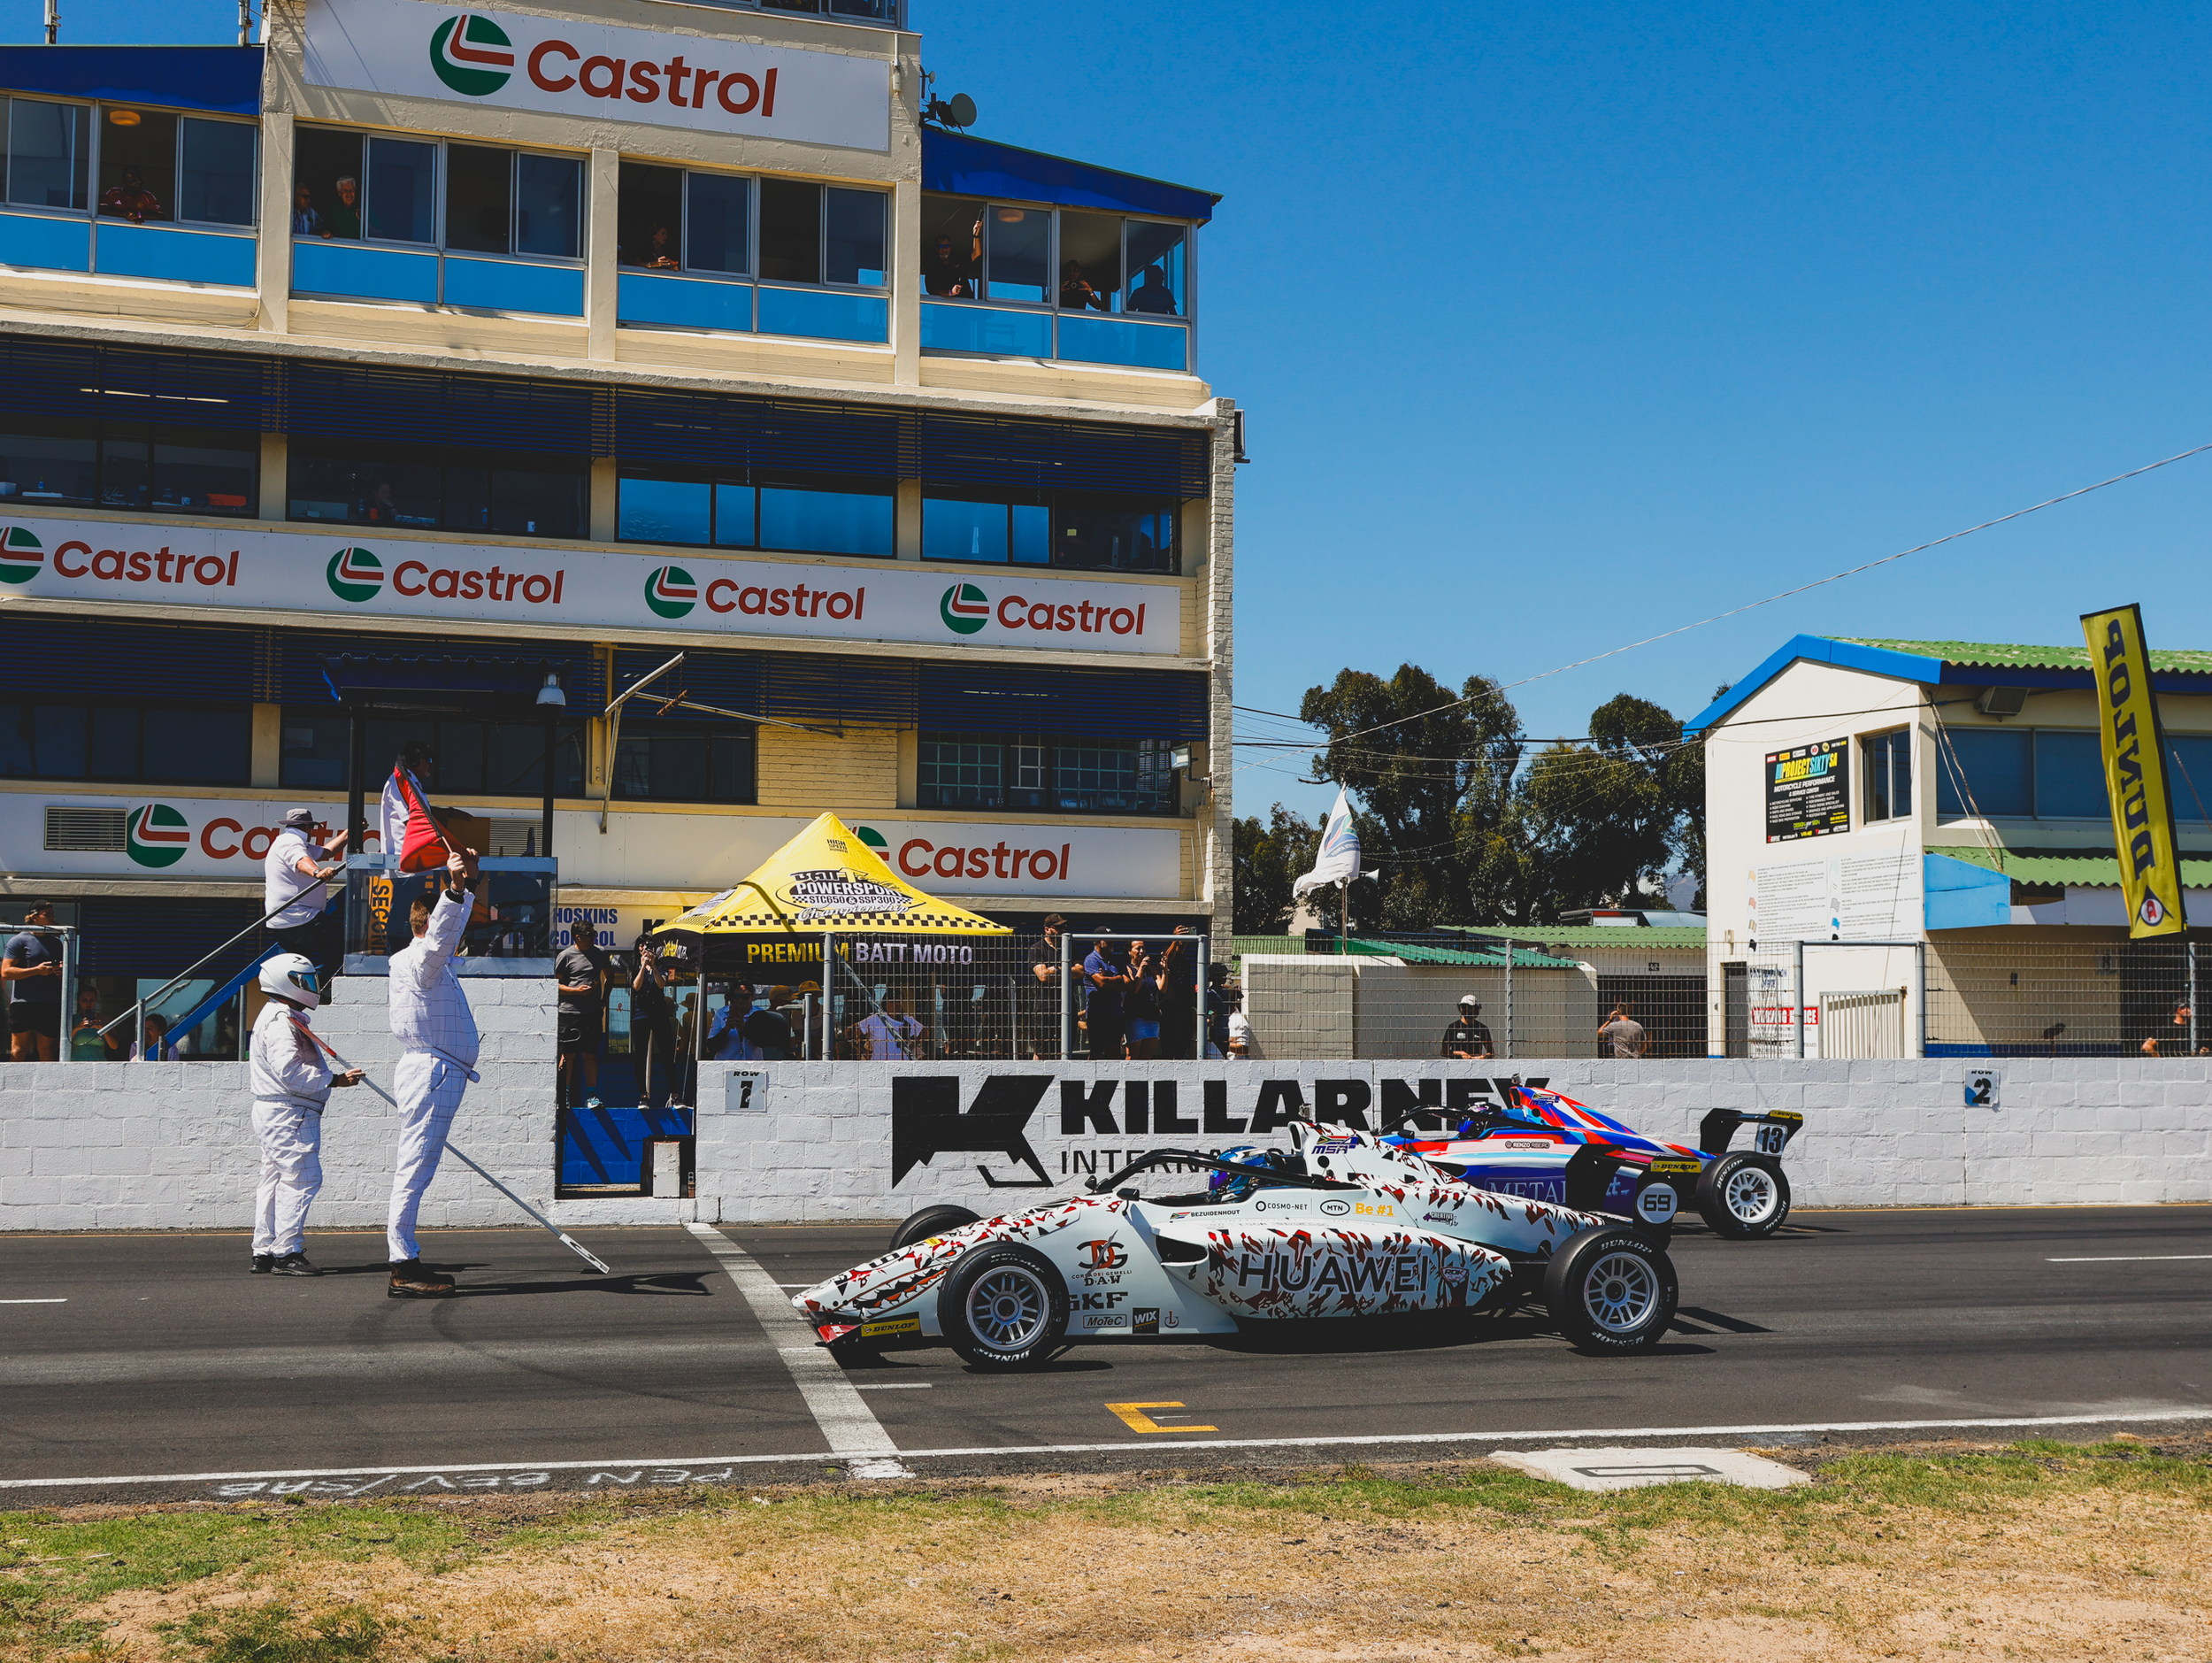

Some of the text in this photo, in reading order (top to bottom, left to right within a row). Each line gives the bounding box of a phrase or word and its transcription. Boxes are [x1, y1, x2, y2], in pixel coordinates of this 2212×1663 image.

[528, 40, 777, 117] Castrol
[54, 542, 238, 586] Castrol
[394, 561, 564, 604] Castrol
[706, 579, 864, 620] Castrol
[998, 596, 1145, 635] Castrol
[1774, 776, 1835, 792] MOTORCYCLE PERFORMANCE
[898, 838, 1070, 880] Castrol
[809, 896, 846, 905] STC650
[859, 896, 895, 905] SSP300
[553, 908, 618, 924] HOSKINS
[798, 902, 910, 921] Championship
[856, 943, 908, 963] BATT
[913, 943, 972, 966] MOTO
[1972, 1078, 1992, 1105] 2
[1311, 1145, 1349, 1155] MSA
[1761, 1127, 1784, 1154] 13
[1717, 1159, 1744, 1190] DUNLOP
[1267, 1202, 1308, 1211] COSMO-NET
[1356, 1202, 1394, 1216] Be #1
[1644, 1194, 1671, 1212] 69
[1238, 1252, 1430, 1293] HUAWEI
[872, 1322, 916, 1333] DUNLOP
[1087, 1316, 1123, 1327] MoTeC
[1134, 1311, 1157, 1324] WIX
